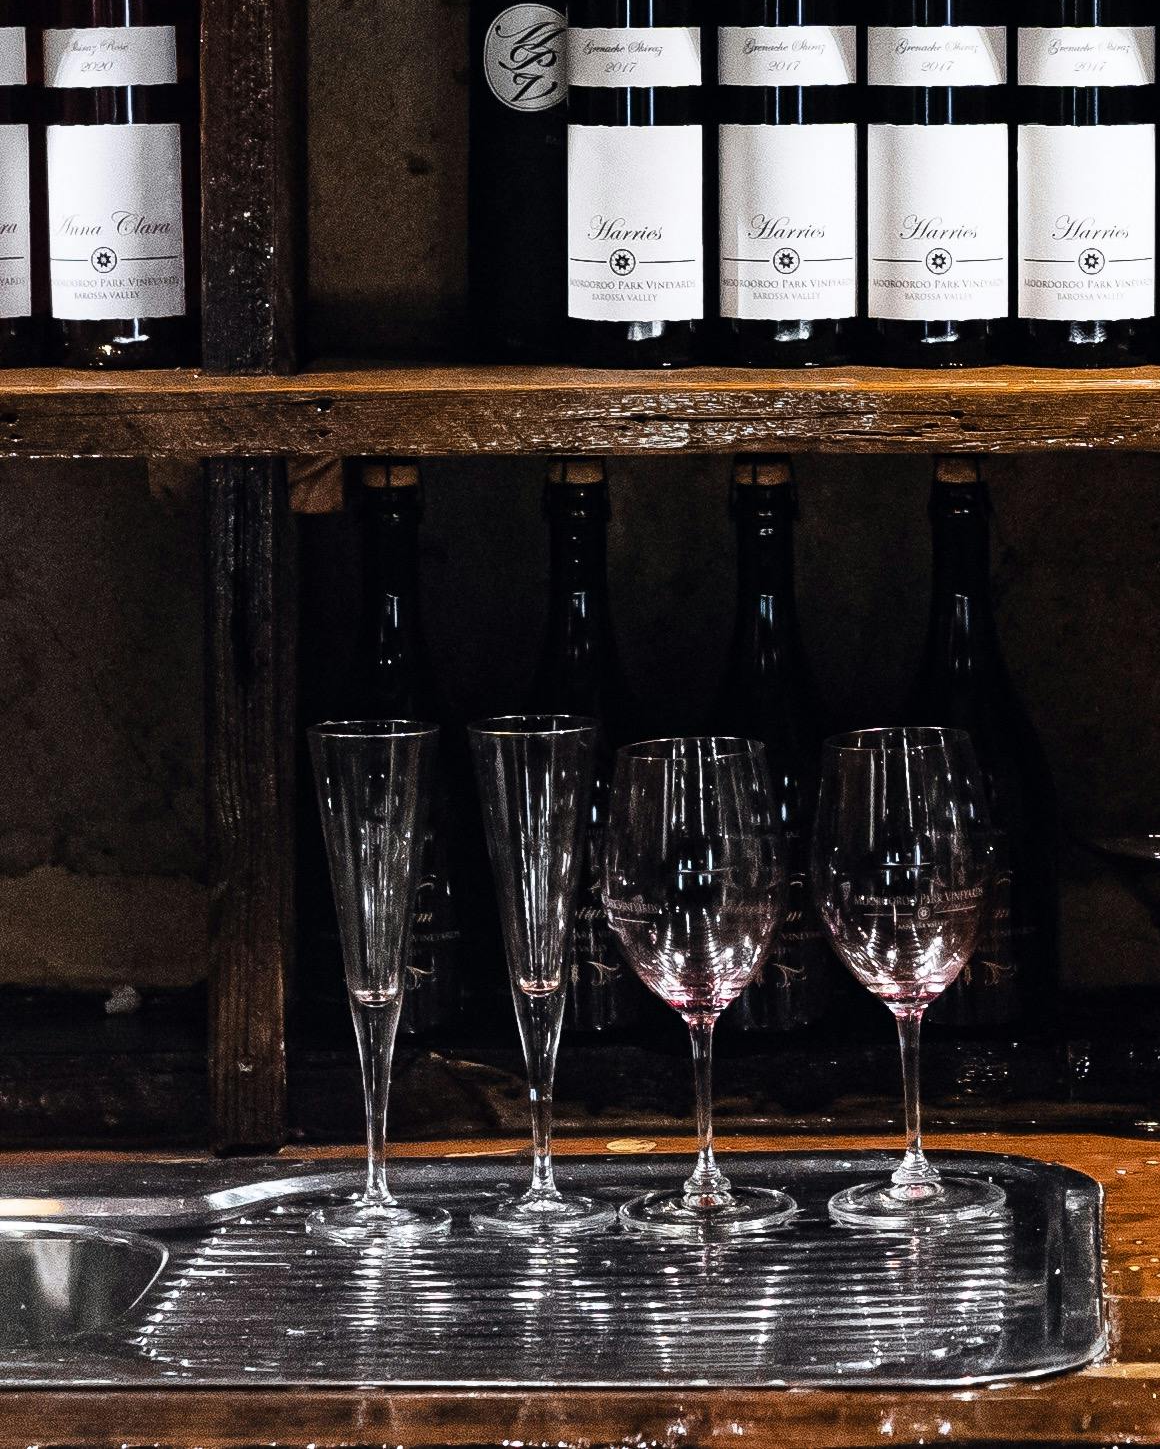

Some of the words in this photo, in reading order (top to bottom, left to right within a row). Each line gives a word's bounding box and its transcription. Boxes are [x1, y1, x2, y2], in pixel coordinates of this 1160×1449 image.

[80, 61, 114, 72] 2020
[604, 61, 638, 74] 2017
[767, 60, 801, 72] 2017
[58, 213, 102, 237] Anna
[110, 210, 171, 236] Clara
[587, 213, 664, 241] Harries
[746, 212, 826, 240] Harries
[899, 213, 979, 241] Harries
[1051, 214, 1130, 241] Harries
[100, 278, 125, 288] PARK
[618, 279, 644, 290] PARK
[782, 278, 809, 290] PARK
[935, 279, 961, 290] PARK
[1087, 279, 1112, 290] PARK
[108, 290, 140, 300] VALLEY
[591, 293, 626, 302] BAROSSA
[627, 293, 658, 302] VALLEY
[752, 291, 788, 301] BAROSSA
